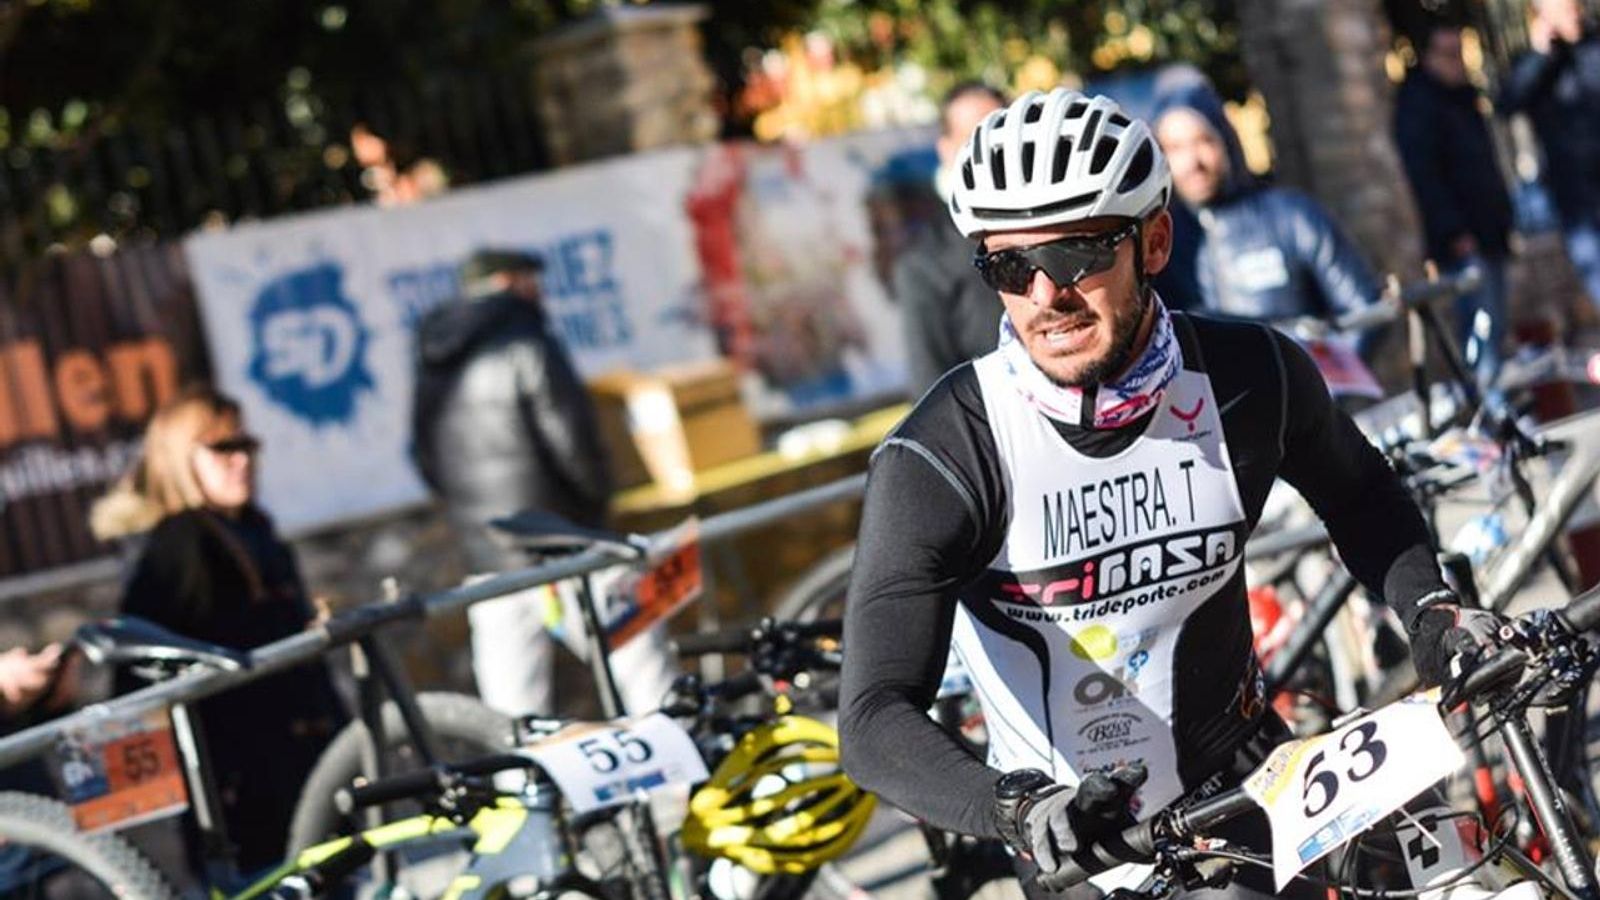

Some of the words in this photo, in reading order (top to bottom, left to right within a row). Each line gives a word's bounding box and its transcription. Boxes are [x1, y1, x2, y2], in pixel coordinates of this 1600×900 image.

[262, 302, 360, 388] SD
[1042, 466, 1177, 561] MAESTRA.
[1179, 459, 1195, 523] T
[1006, 569, 1227, 623] www.trideporte.com
[122, 738, 162, 786] 55
[578, 730, 653, 774] 55
[1302, 721, 1388, 818] 53
